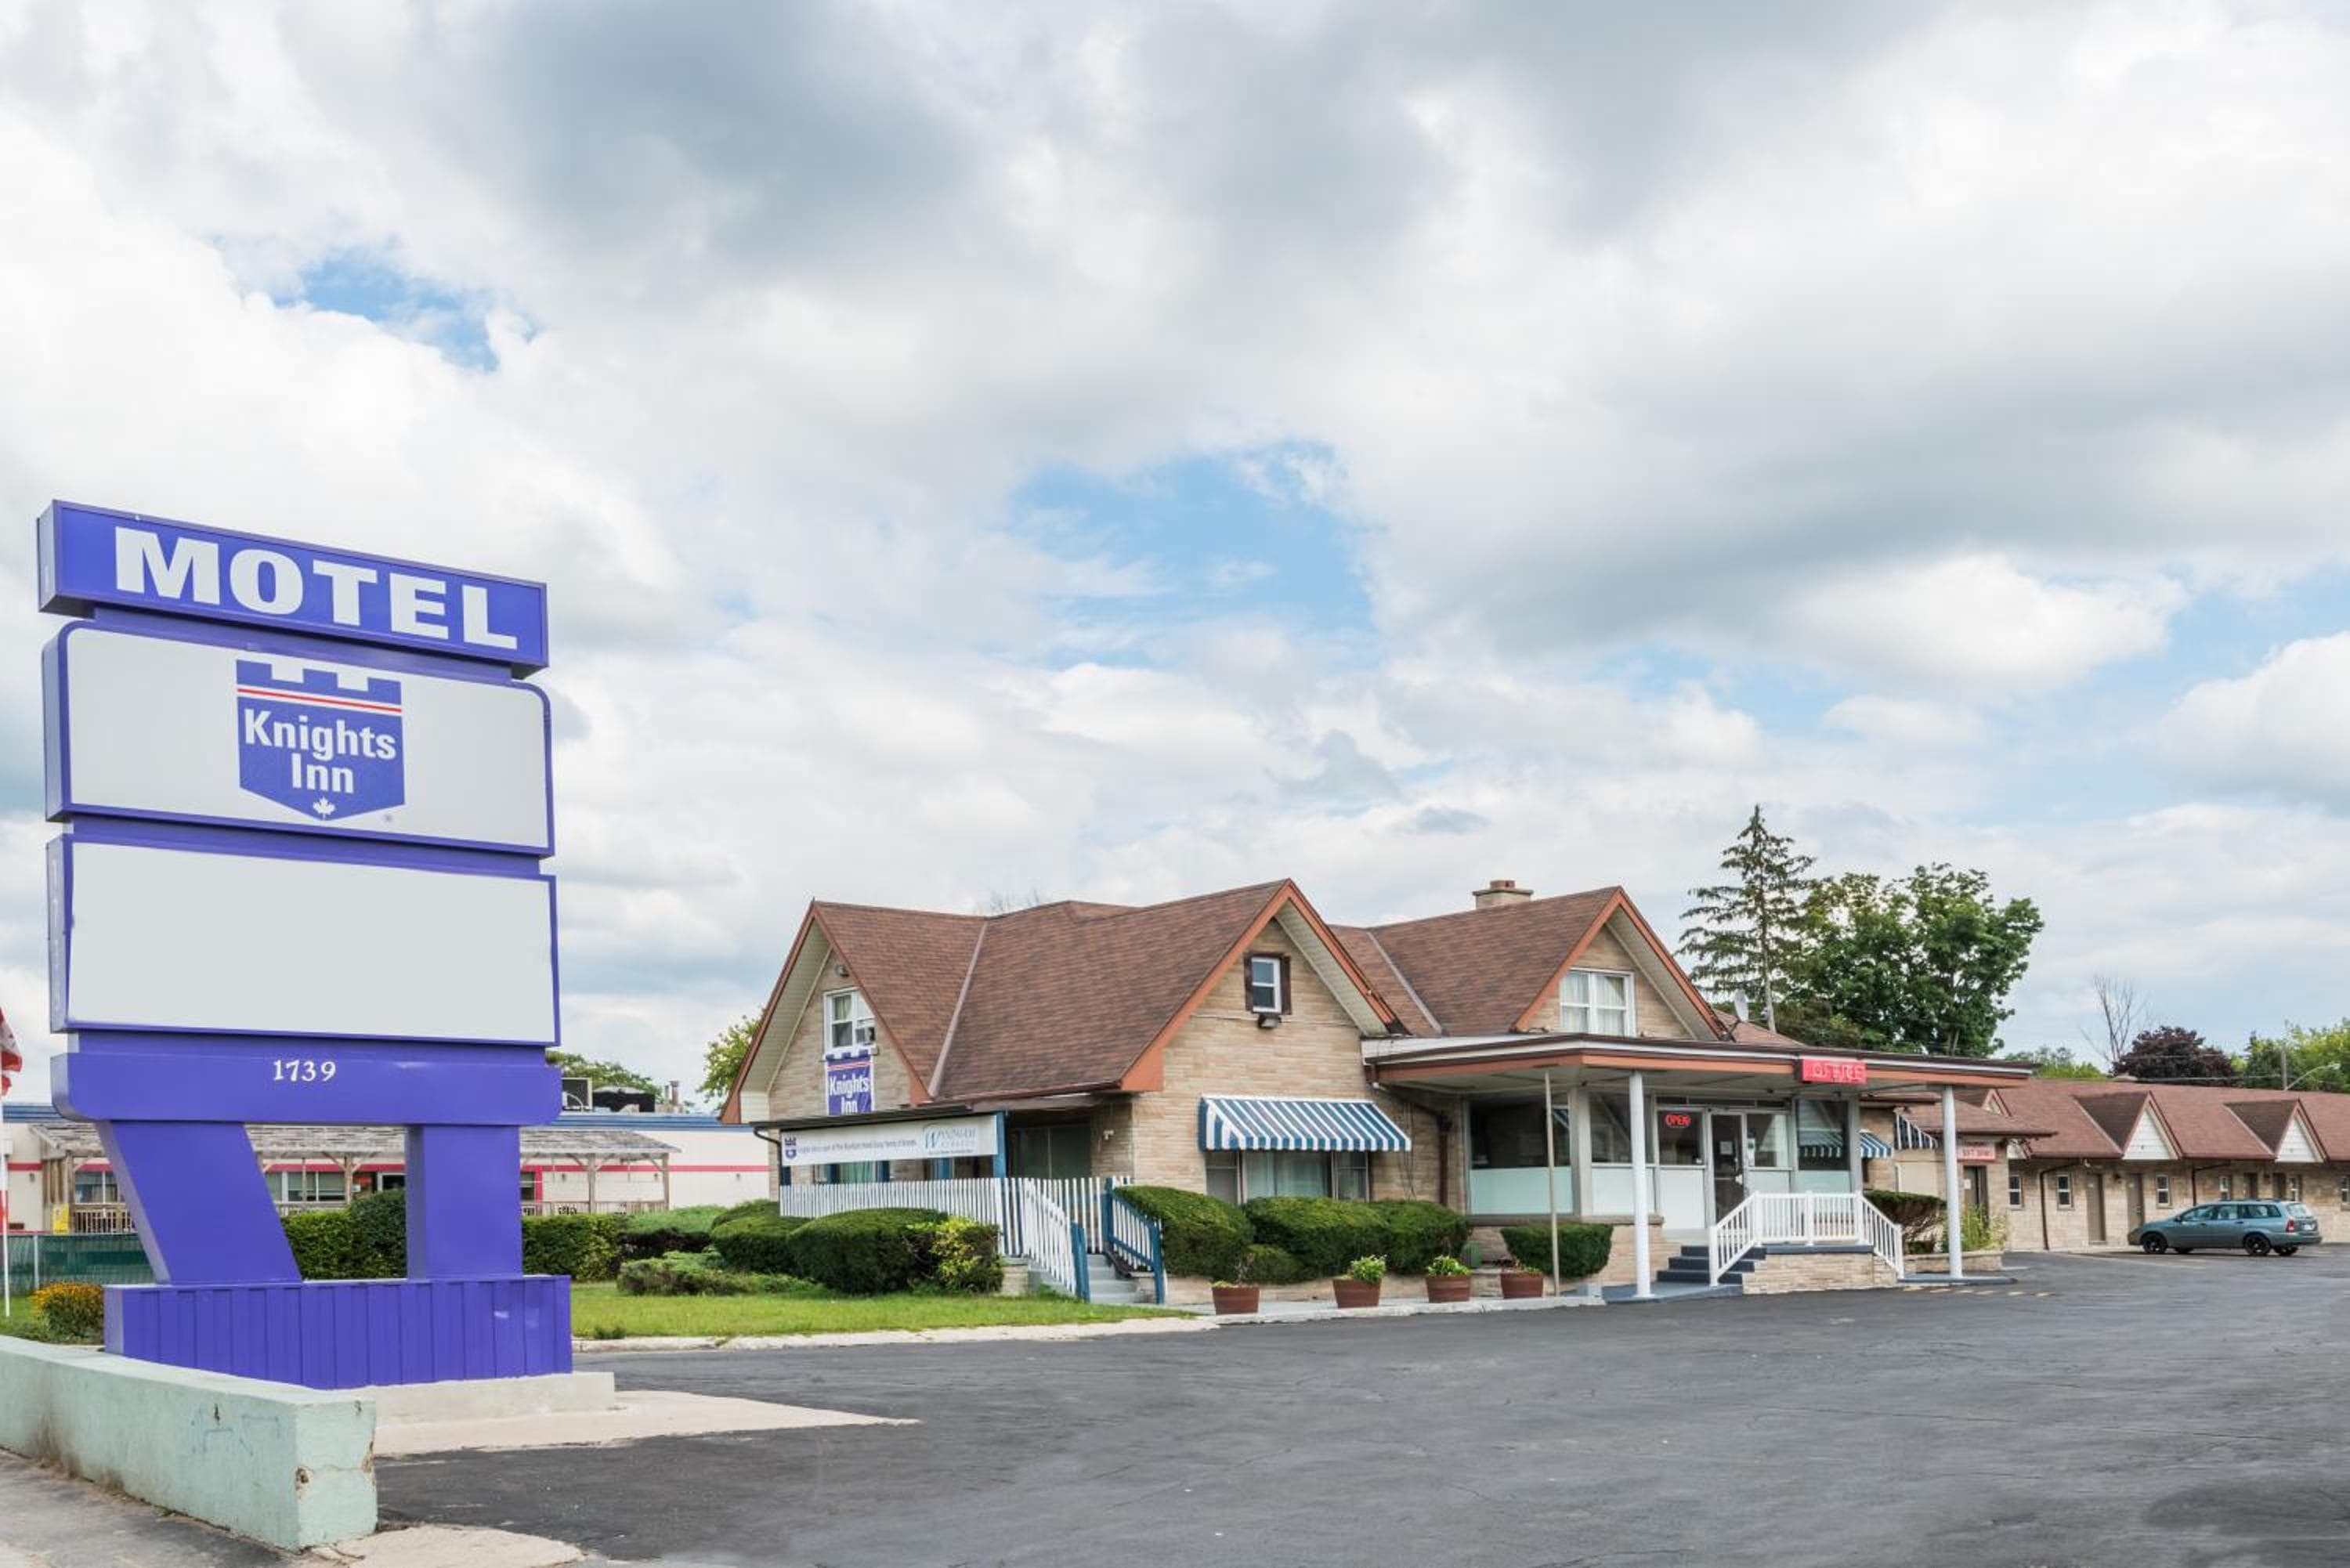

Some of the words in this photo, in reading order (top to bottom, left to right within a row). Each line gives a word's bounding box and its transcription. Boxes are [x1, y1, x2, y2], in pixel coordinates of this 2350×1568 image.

[114, 526, 518, 650] MOTEL
[244, 708, 396, 761] Knights
[291, 752, 355, 794] Inn
[273, 1060, 336, 1082] 1739
[830, 1074, 869, 1099] Knights
[841, 1097, 859, 1116] Inn
